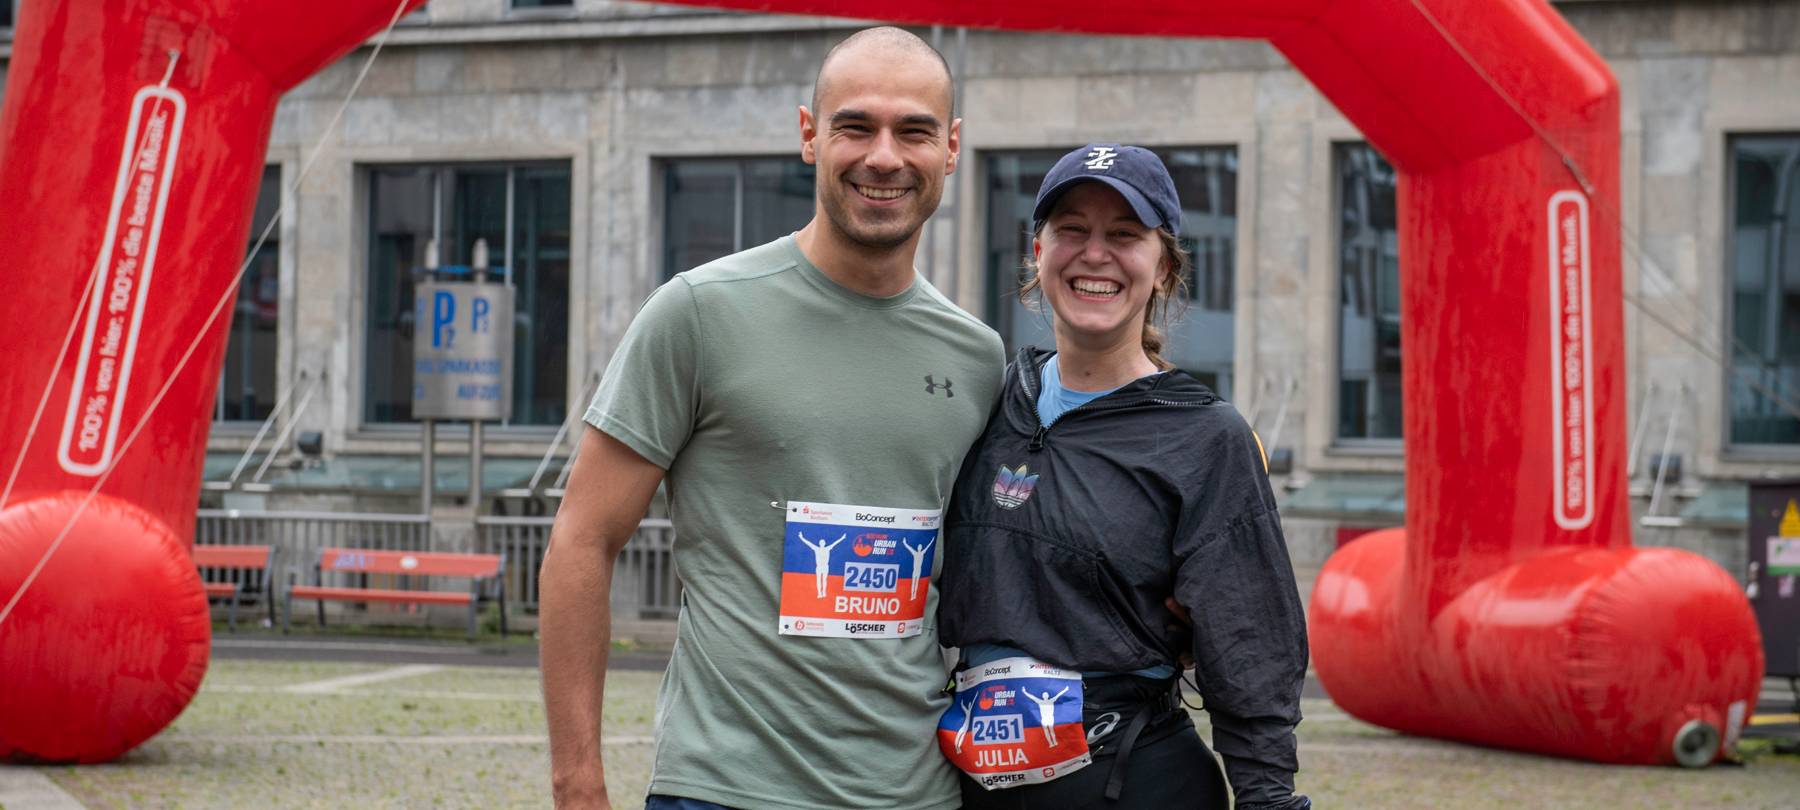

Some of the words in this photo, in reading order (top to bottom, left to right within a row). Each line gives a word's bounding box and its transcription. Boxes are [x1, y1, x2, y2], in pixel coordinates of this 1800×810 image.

[127, 173, 154, 226] beste
[122, 226, 143, 257] die
[109, 258, 137, 314] 100%
[96, 358, 116, 392] von
[79, 395, 107, 452] 100%
[855, 512, 896, 525] BoConcept
[872, 547, 887, 555] RUN
[873, 539, 897, 548] URBAN
[845, 567, 897, 588] 2450
[834, 596, 900, 616] BRUNO
[845, 623, 886, 634] LÖSCHER
[984, 665, 1011, 677] BoConcept
[993, 698, 1007, 707] RUN
[994, 690, 1016, 699] URBAN
[974, 718, 1020, 741] 2451
[975, 748, 1029, 768] JULIA
[981, 773, 1025, 786] LÖSCHER
